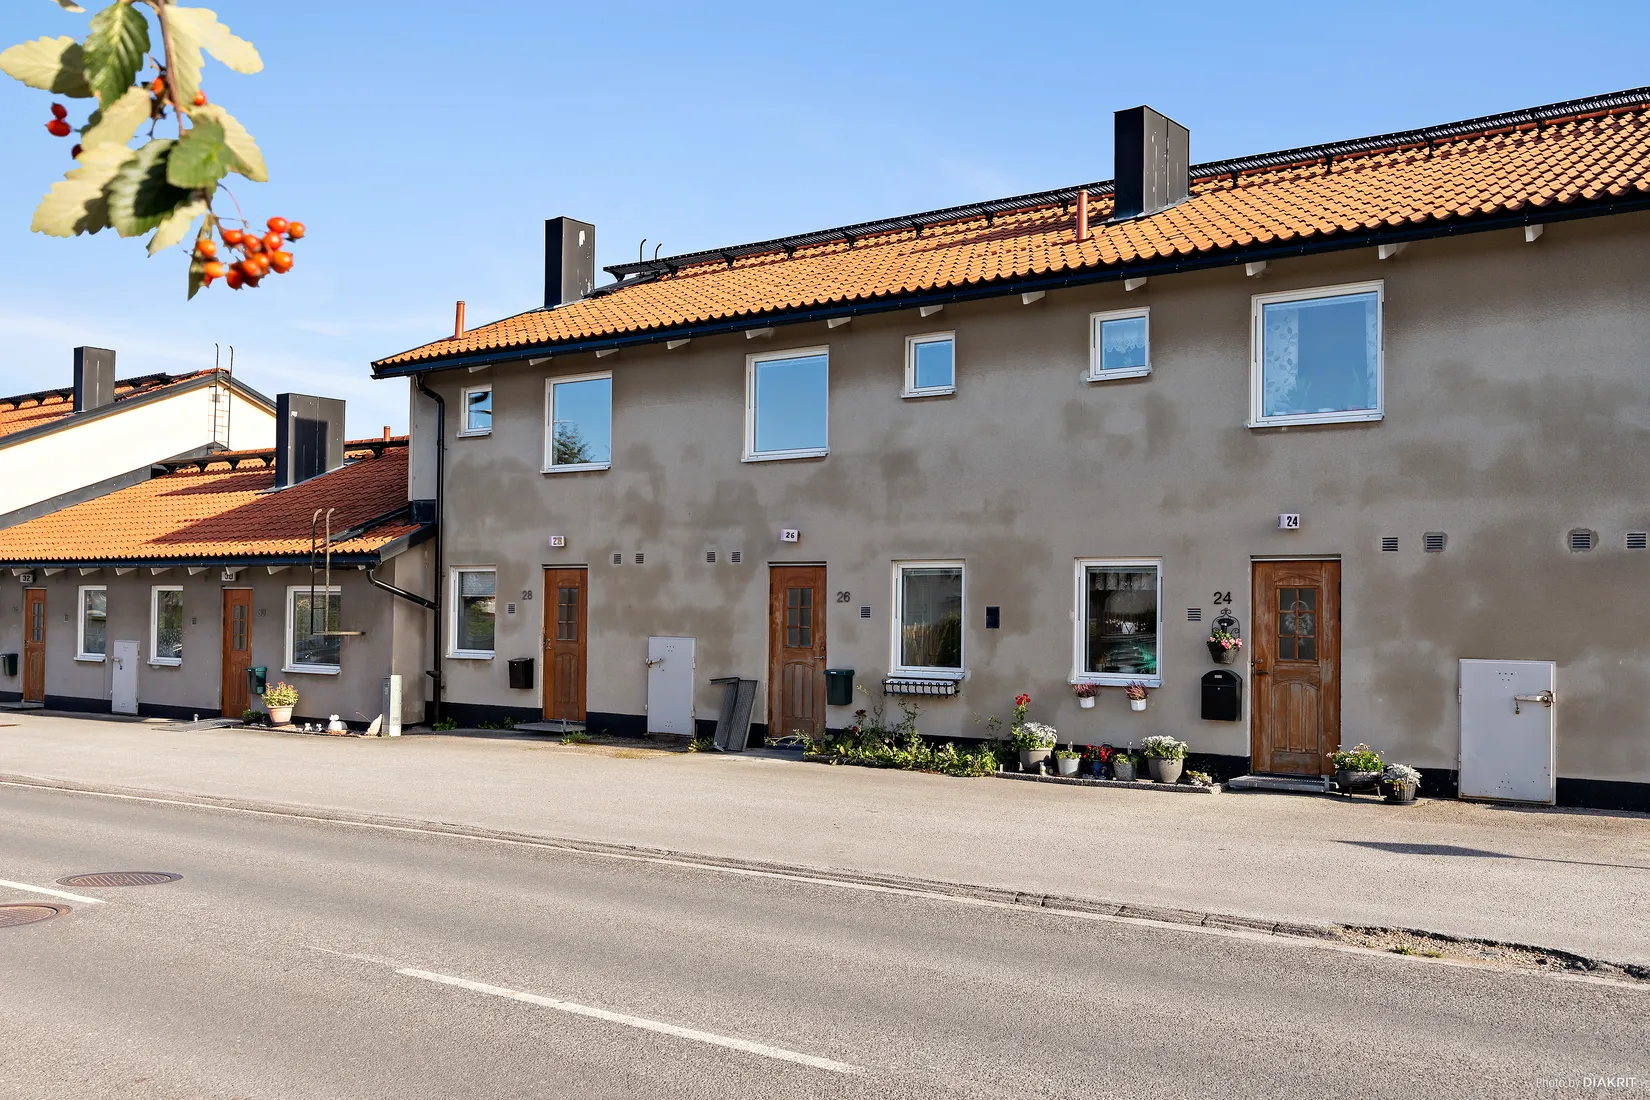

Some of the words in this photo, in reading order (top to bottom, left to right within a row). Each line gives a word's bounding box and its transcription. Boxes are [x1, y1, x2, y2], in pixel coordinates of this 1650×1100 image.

[1286, 516, 1298, 527] 24
[785, 531, 795, 539] 26
[553, 537, 562, 545] 28
[522, 590, 532, 600] 28
[836, 591, 851, 603] 26
[1213, 591, 1232, 605] 24
